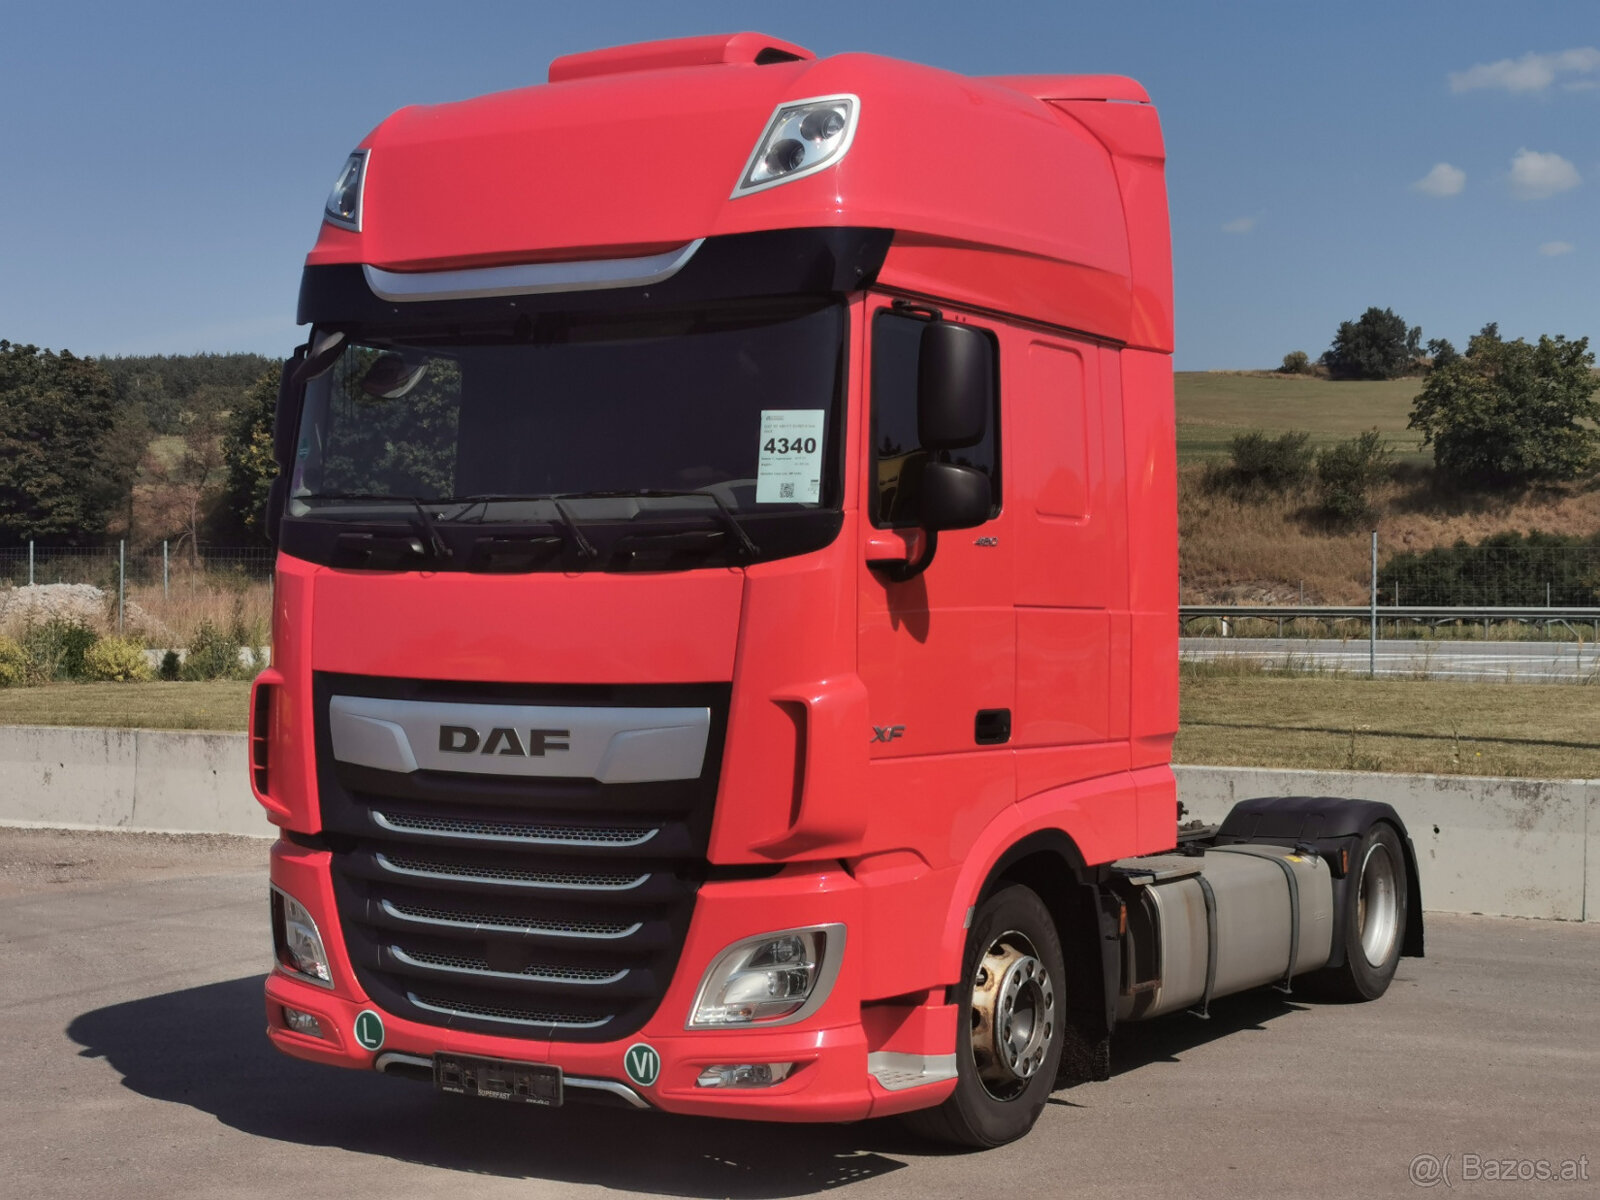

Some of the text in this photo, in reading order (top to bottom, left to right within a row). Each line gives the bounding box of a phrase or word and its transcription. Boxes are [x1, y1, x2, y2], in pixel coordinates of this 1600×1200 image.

[763, 437, 816, 454] 4340
[439, 725, 570, 757] DAF
[870, 725, 906, 743] XF
[363, 1017, 376, 1044] L
[631, 1050, 654, 1079] VI
[478, 1089, 511, 1100] SUPERFAST
